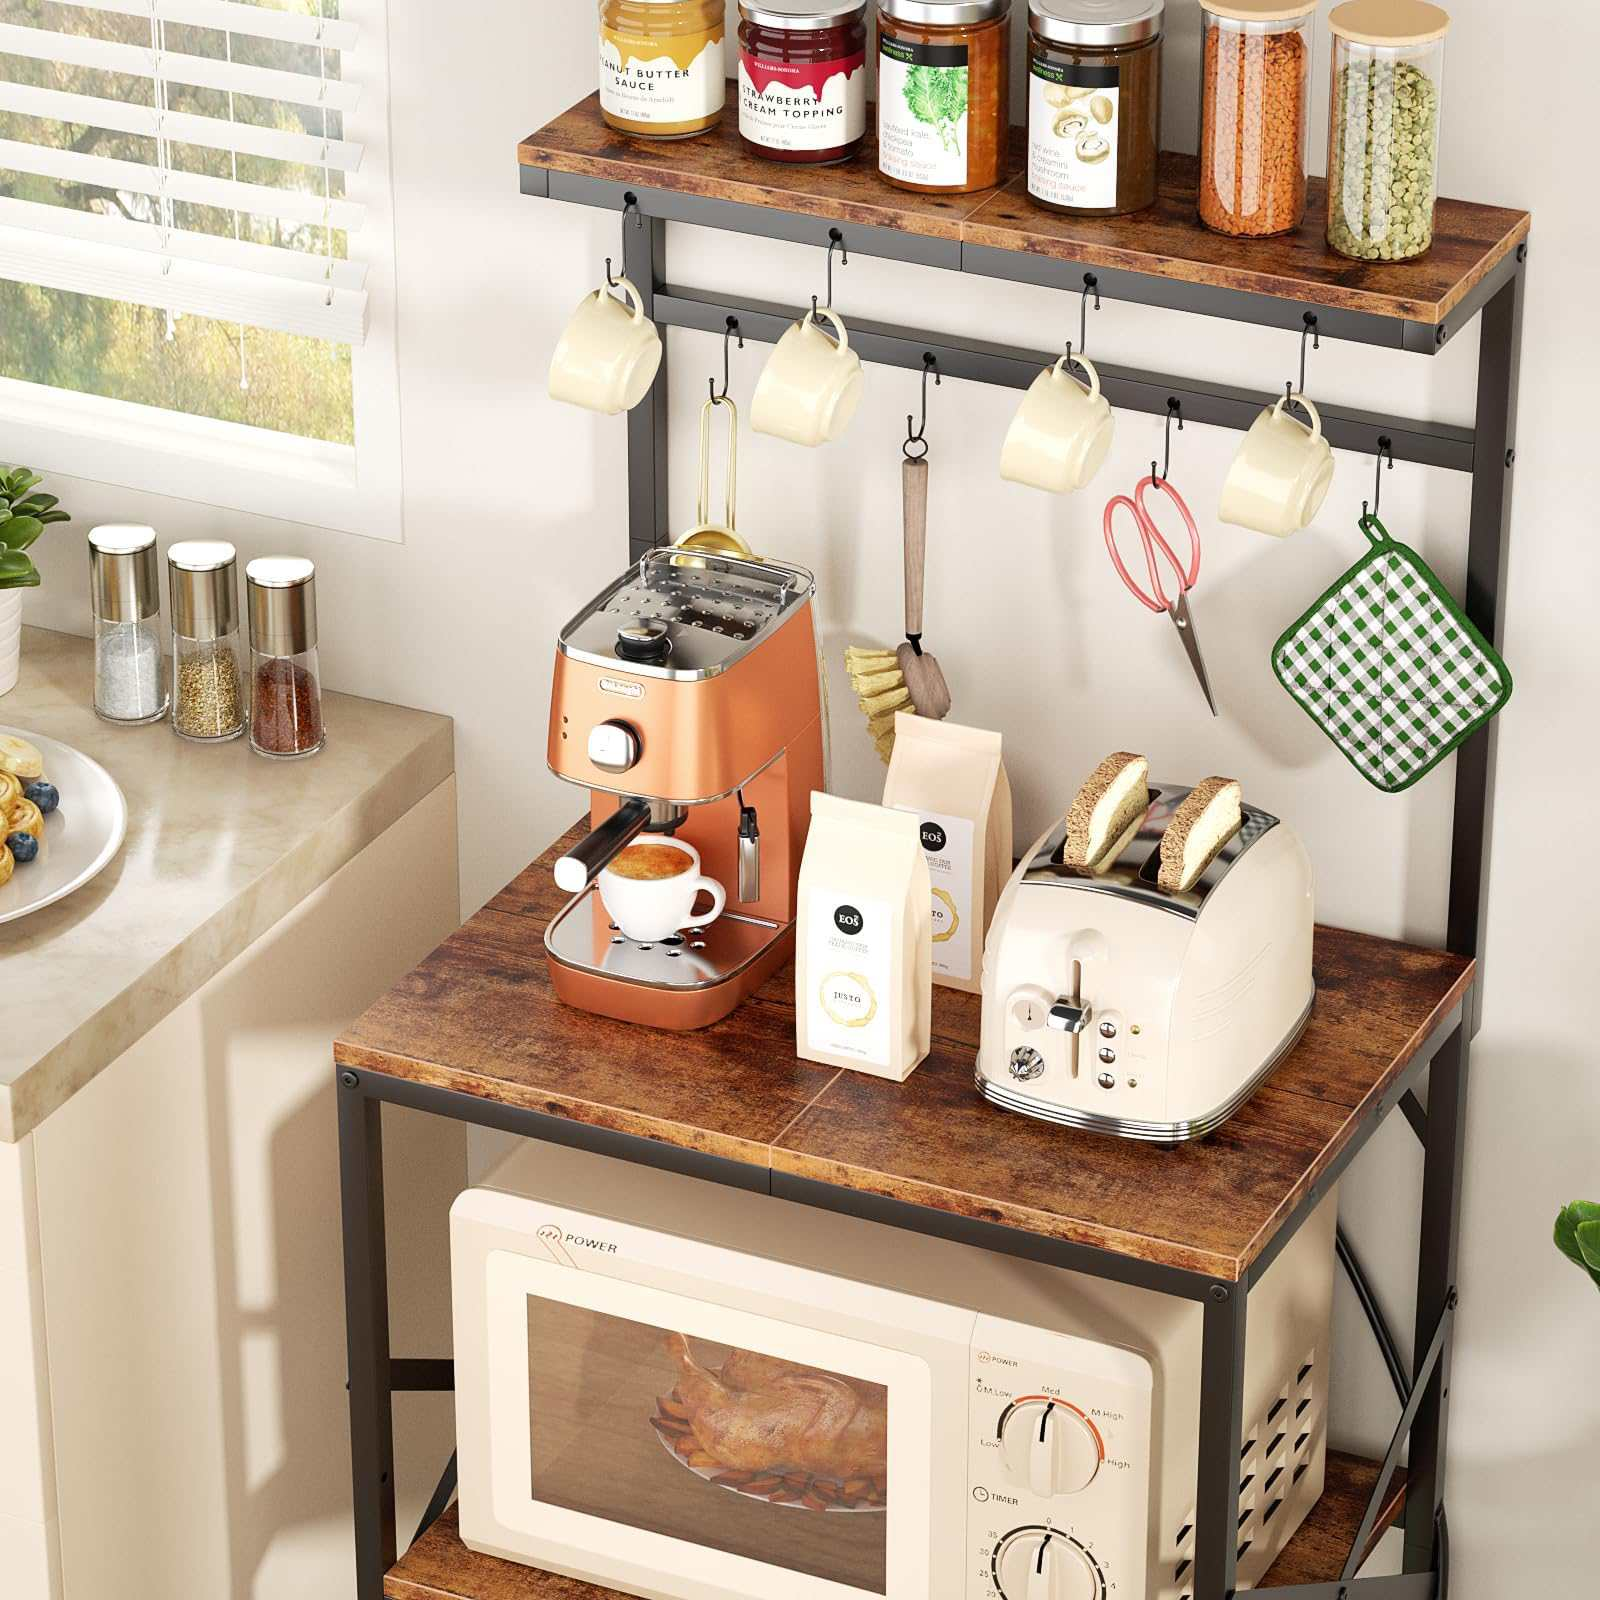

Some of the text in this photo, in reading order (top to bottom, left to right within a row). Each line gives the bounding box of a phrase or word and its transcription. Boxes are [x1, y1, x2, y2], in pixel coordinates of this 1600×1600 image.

[637, 69, 690, 79] BUTTER
[615, 77, 655, 91] SAUCE
[742, 84, 821, 106] STRAWBERRY
[743, 98, 844, 119] CREAM TOPPING
[833, 991, 862, 1004] JUSTO
[565, 1234, 617, 1253] POWER
[991, 1355, 1019, 1368] POWER
[1041, 1385, 1061, 1396] Med
[980, 1439, 1001, 1449] Low
[1107, 1458, 1131, 1470] High
[991, 1493, 1019, 1506] TIMER
[1088, 1541, 1094, 1550] 2
[979, 1569, 990, 1578] 25
